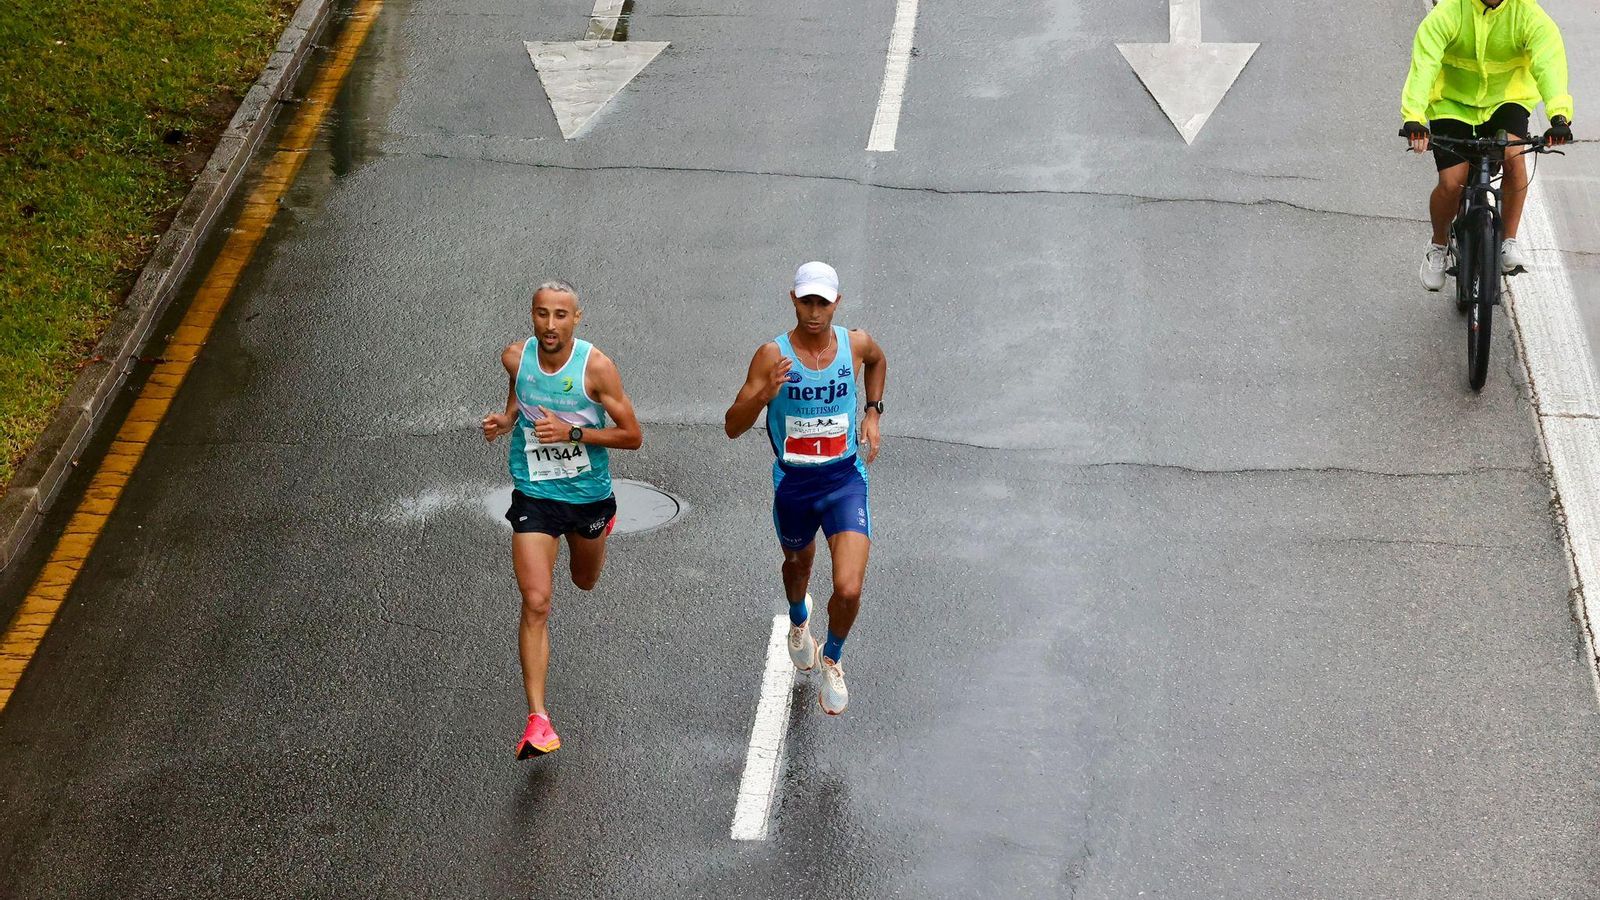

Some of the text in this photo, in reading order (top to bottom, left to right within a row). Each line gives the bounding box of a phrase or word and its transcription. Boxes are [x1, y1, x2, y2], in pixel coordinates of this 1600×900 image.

[787, 380, 848, 404] nerja
[795, 405, 839, 415] ATLETISMO
[532, 445, 582, 462] 11344
[813, 440, 821, 455] 1
